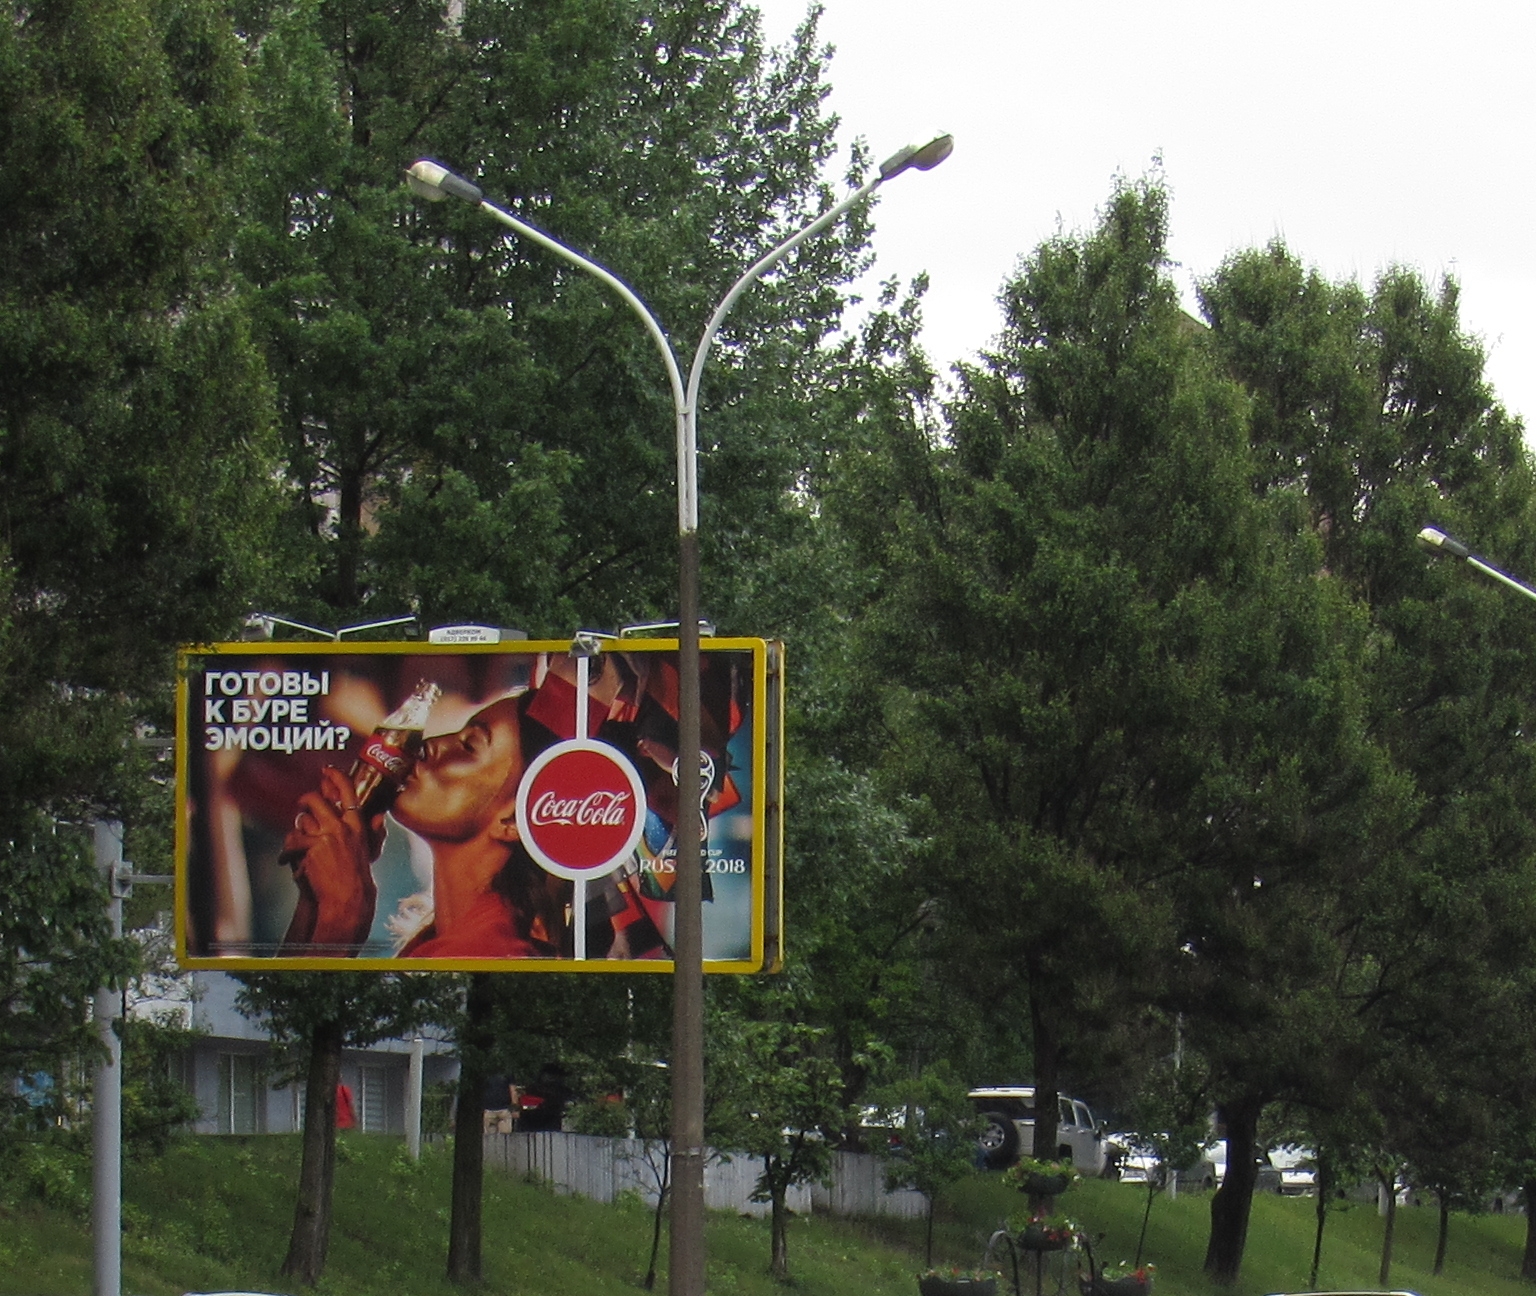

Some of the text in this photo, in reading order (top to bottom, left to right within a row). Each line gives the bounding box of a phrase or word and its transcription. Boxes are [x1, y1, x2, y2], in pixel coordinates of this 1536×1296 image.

[205, 671, 330, 696] ГОТОВЫ
[205, 699, 309, 723] К БУРЕ
[205, 720, 351, 755] ЭМОЦИЙ?
[531, 791, 632, 826] Coca-Cola
[639, 858, 746, 874] RUS 2018
